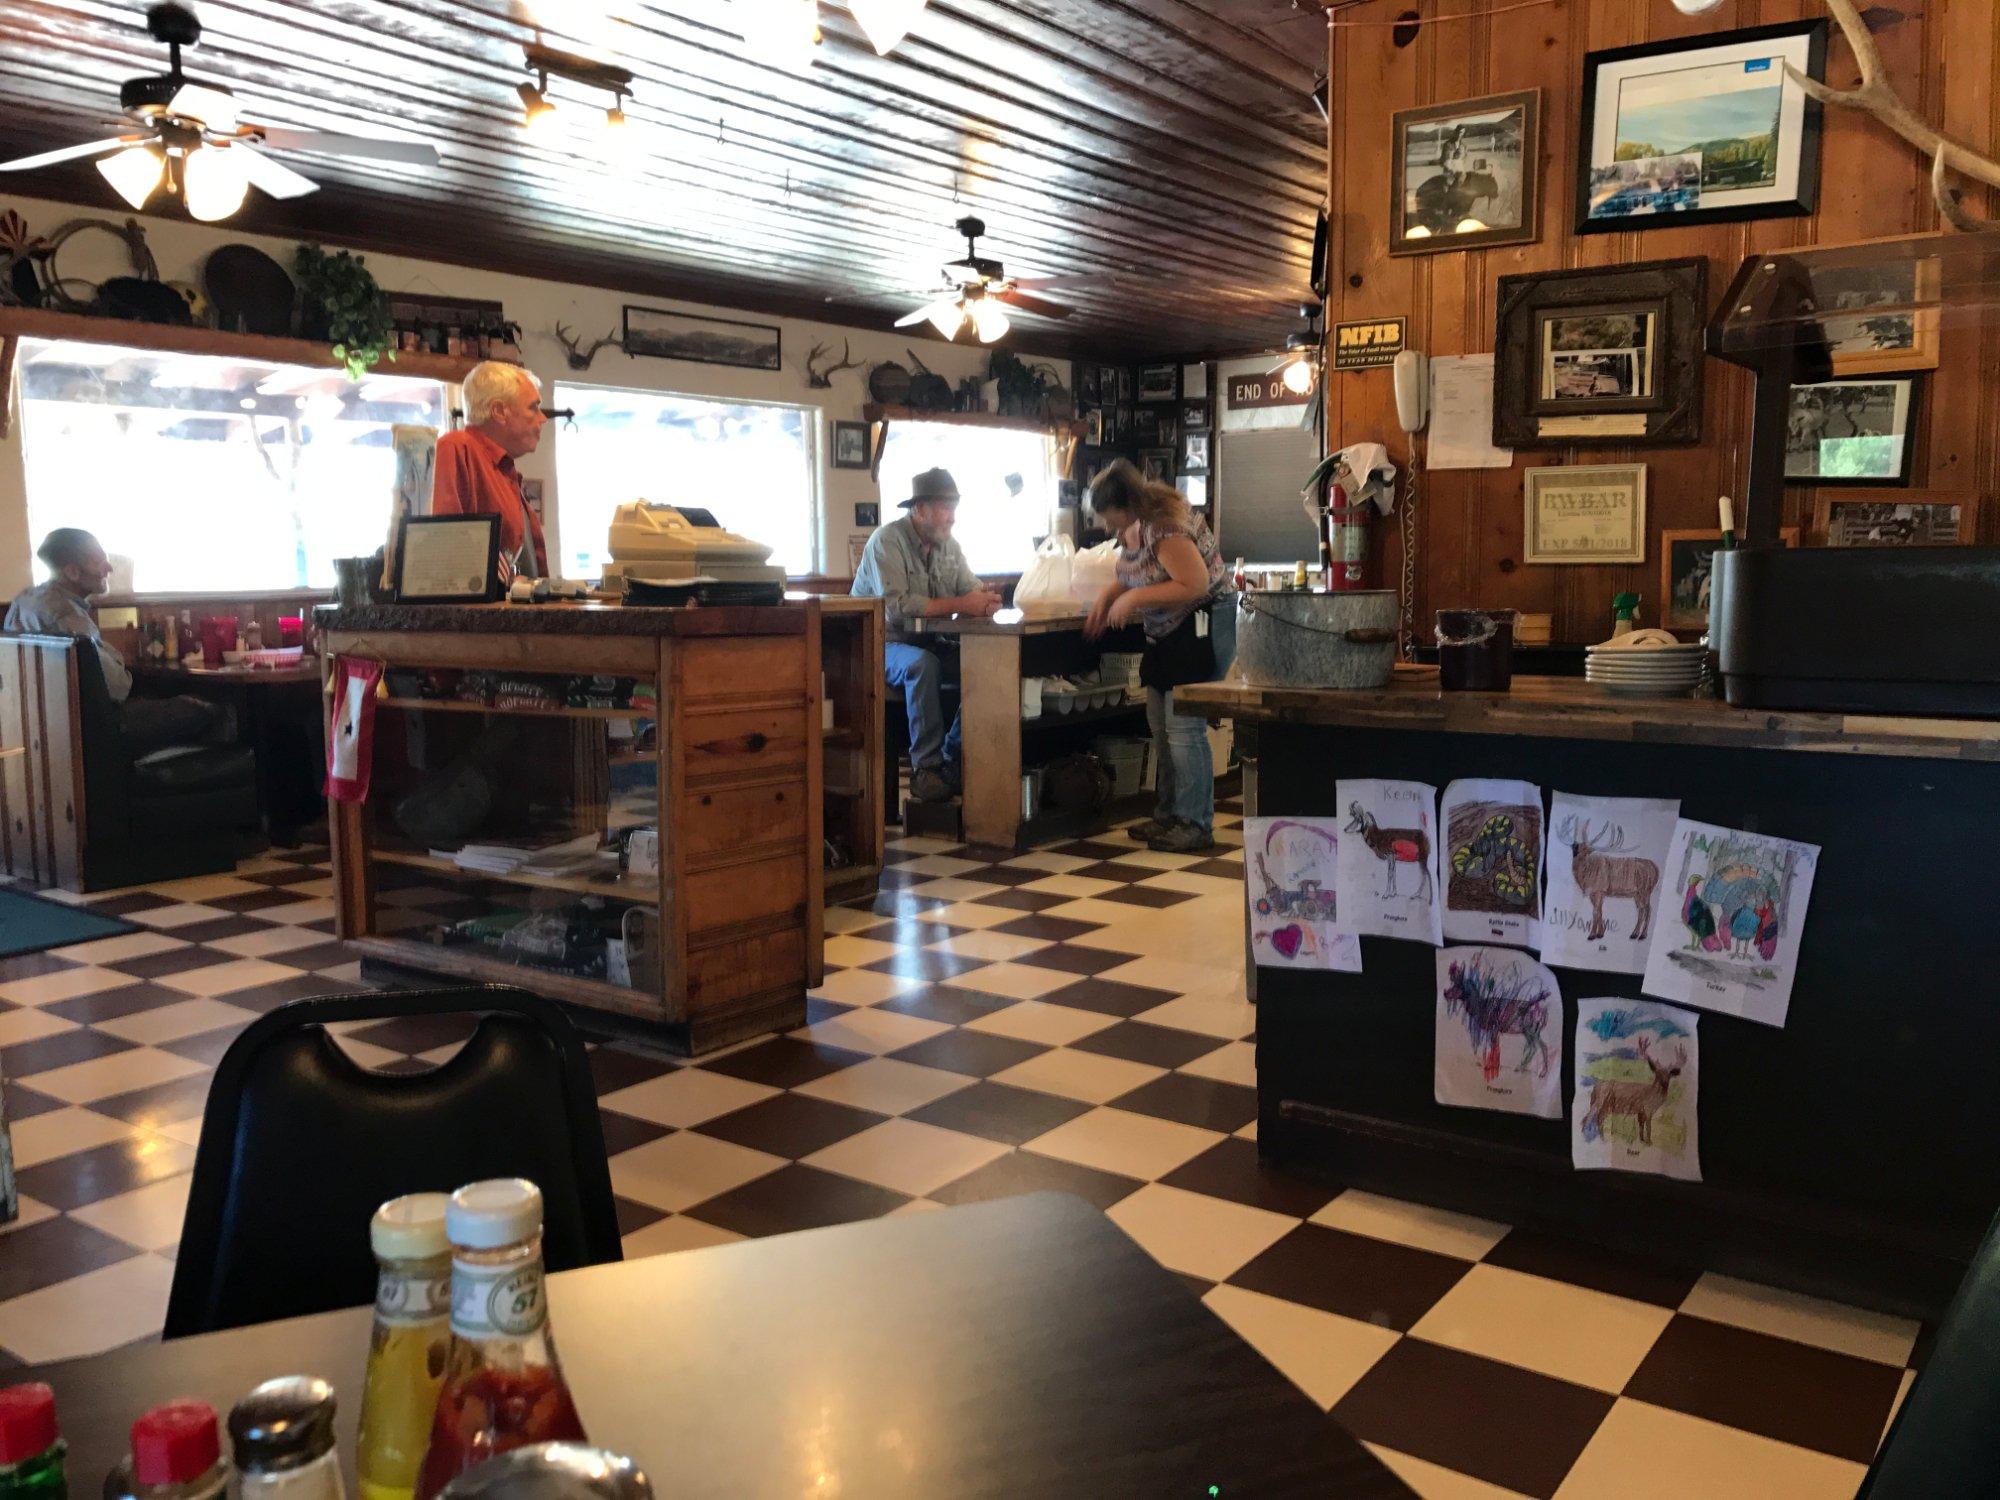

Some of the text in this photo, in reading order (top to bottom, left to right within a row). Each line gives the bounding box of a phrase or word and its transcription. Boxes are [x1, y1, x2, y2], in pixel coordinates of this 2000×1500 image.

[1340, 323, 1400, 346] NFIB
[1368, 354, 1398, 363] MEMBE
[1236, 384, 1261, 401] END
[1270, 381, 1286, 399] OF
